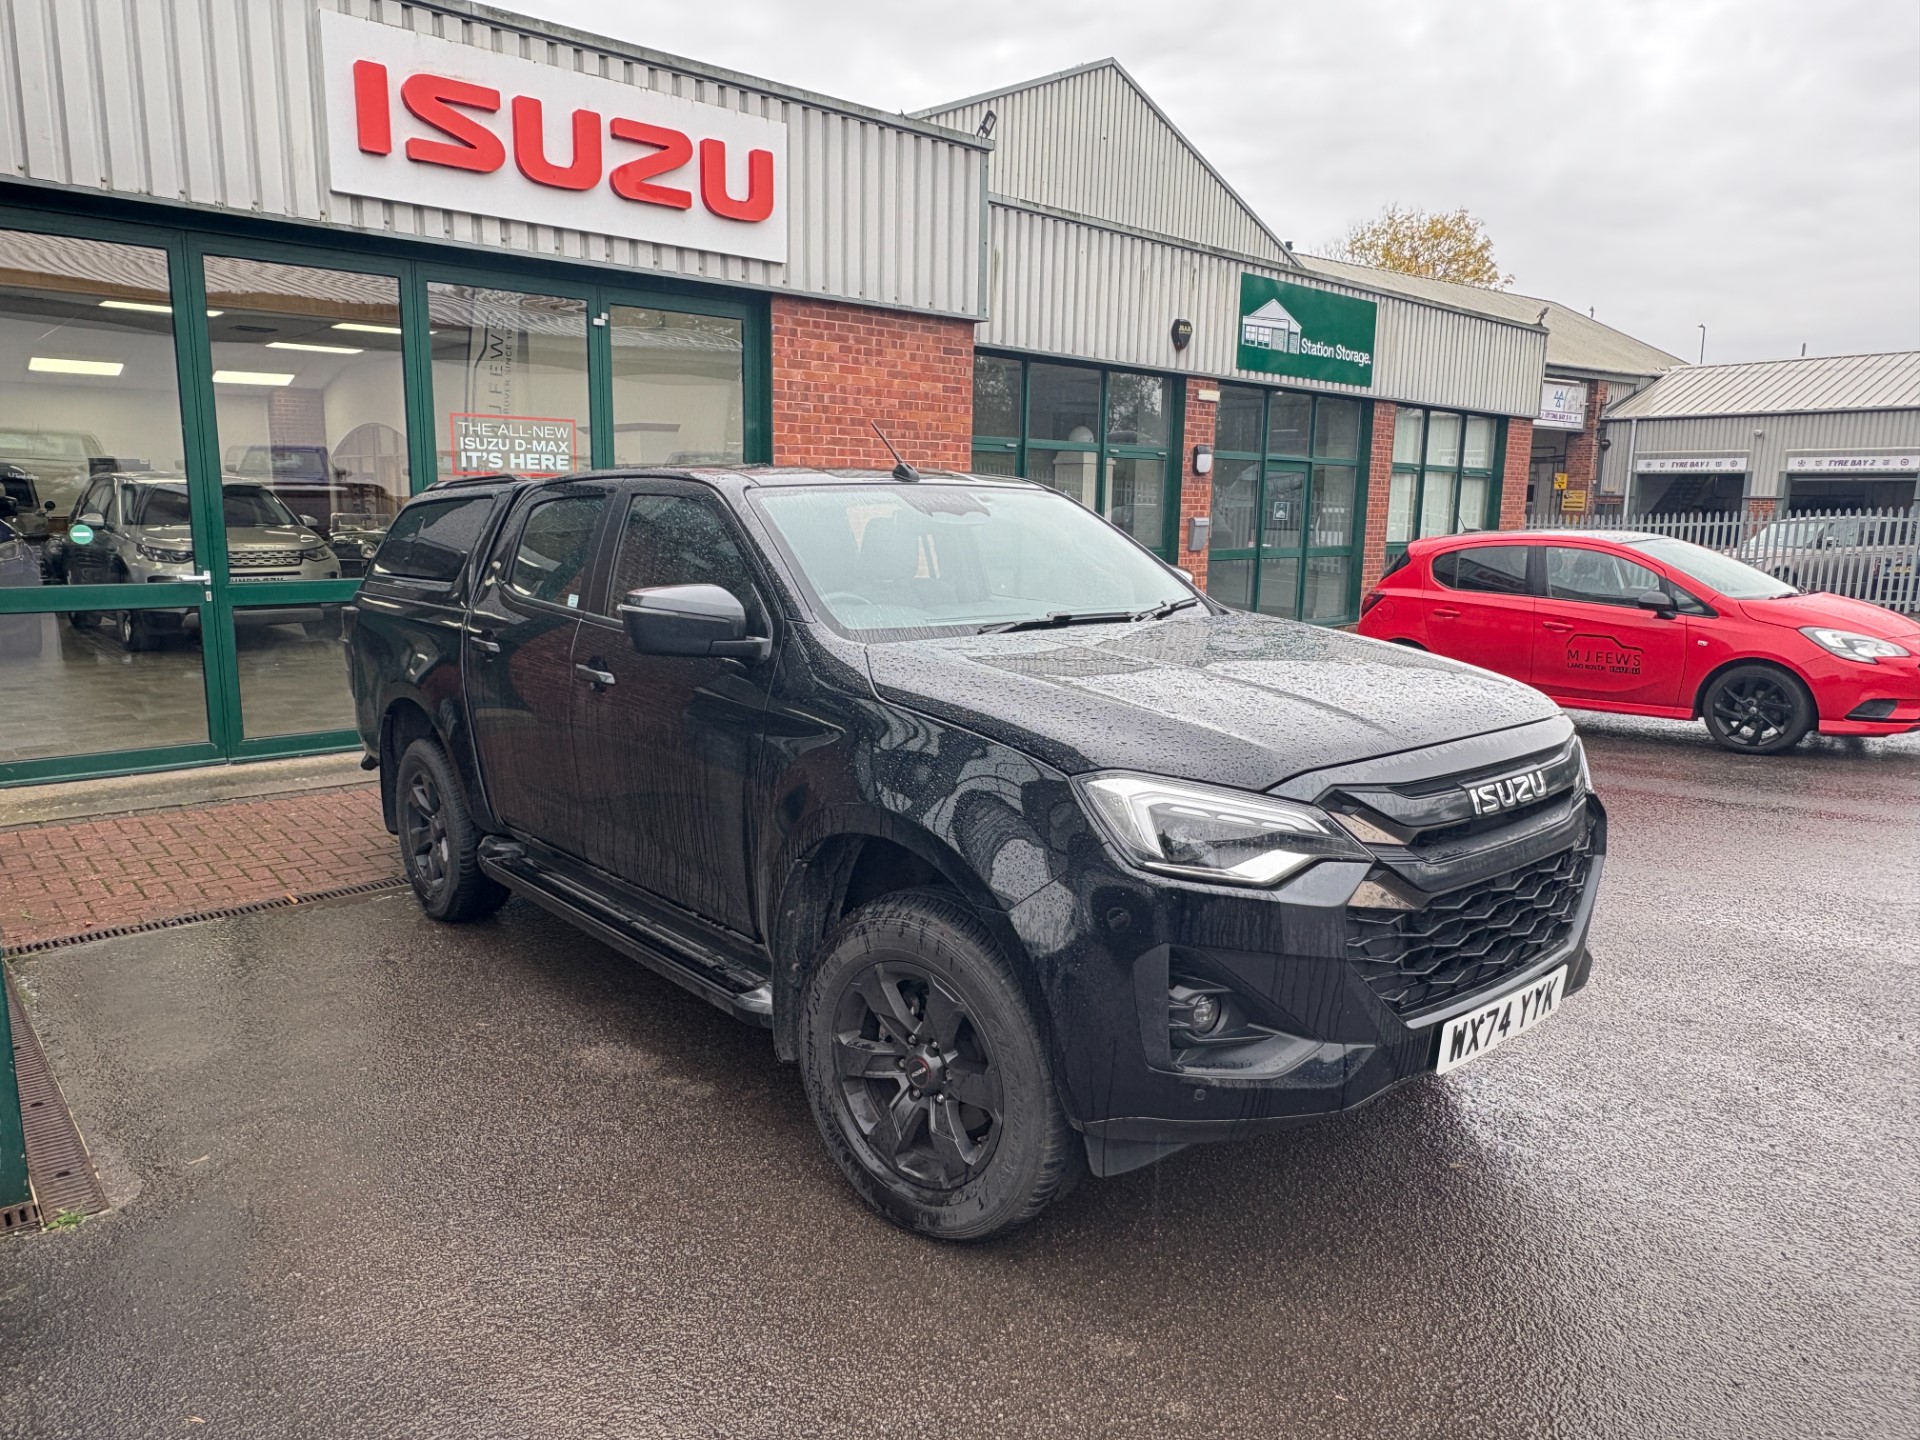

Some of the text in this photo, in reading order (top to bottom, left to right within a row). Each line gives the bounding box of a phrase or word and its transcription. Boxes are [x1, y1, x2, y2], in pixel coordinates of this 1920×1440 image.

[353, 59, 774, 222] ISUZU
[1301, 337, 1335, 359] Station
[458, 422, 494, 436] THE
[498, 424, 570, 439] ALL-NEW
[460, 436, 569, 453] ISUZU D-MAX
[460, 451, 570, 471] IT'S HERE
[1567, 649, 1641, 667] M J FEWS
[1469, 770, 1548, 815] ISUZU
[1449, 976, 1559, 1063] WX74 YYK
